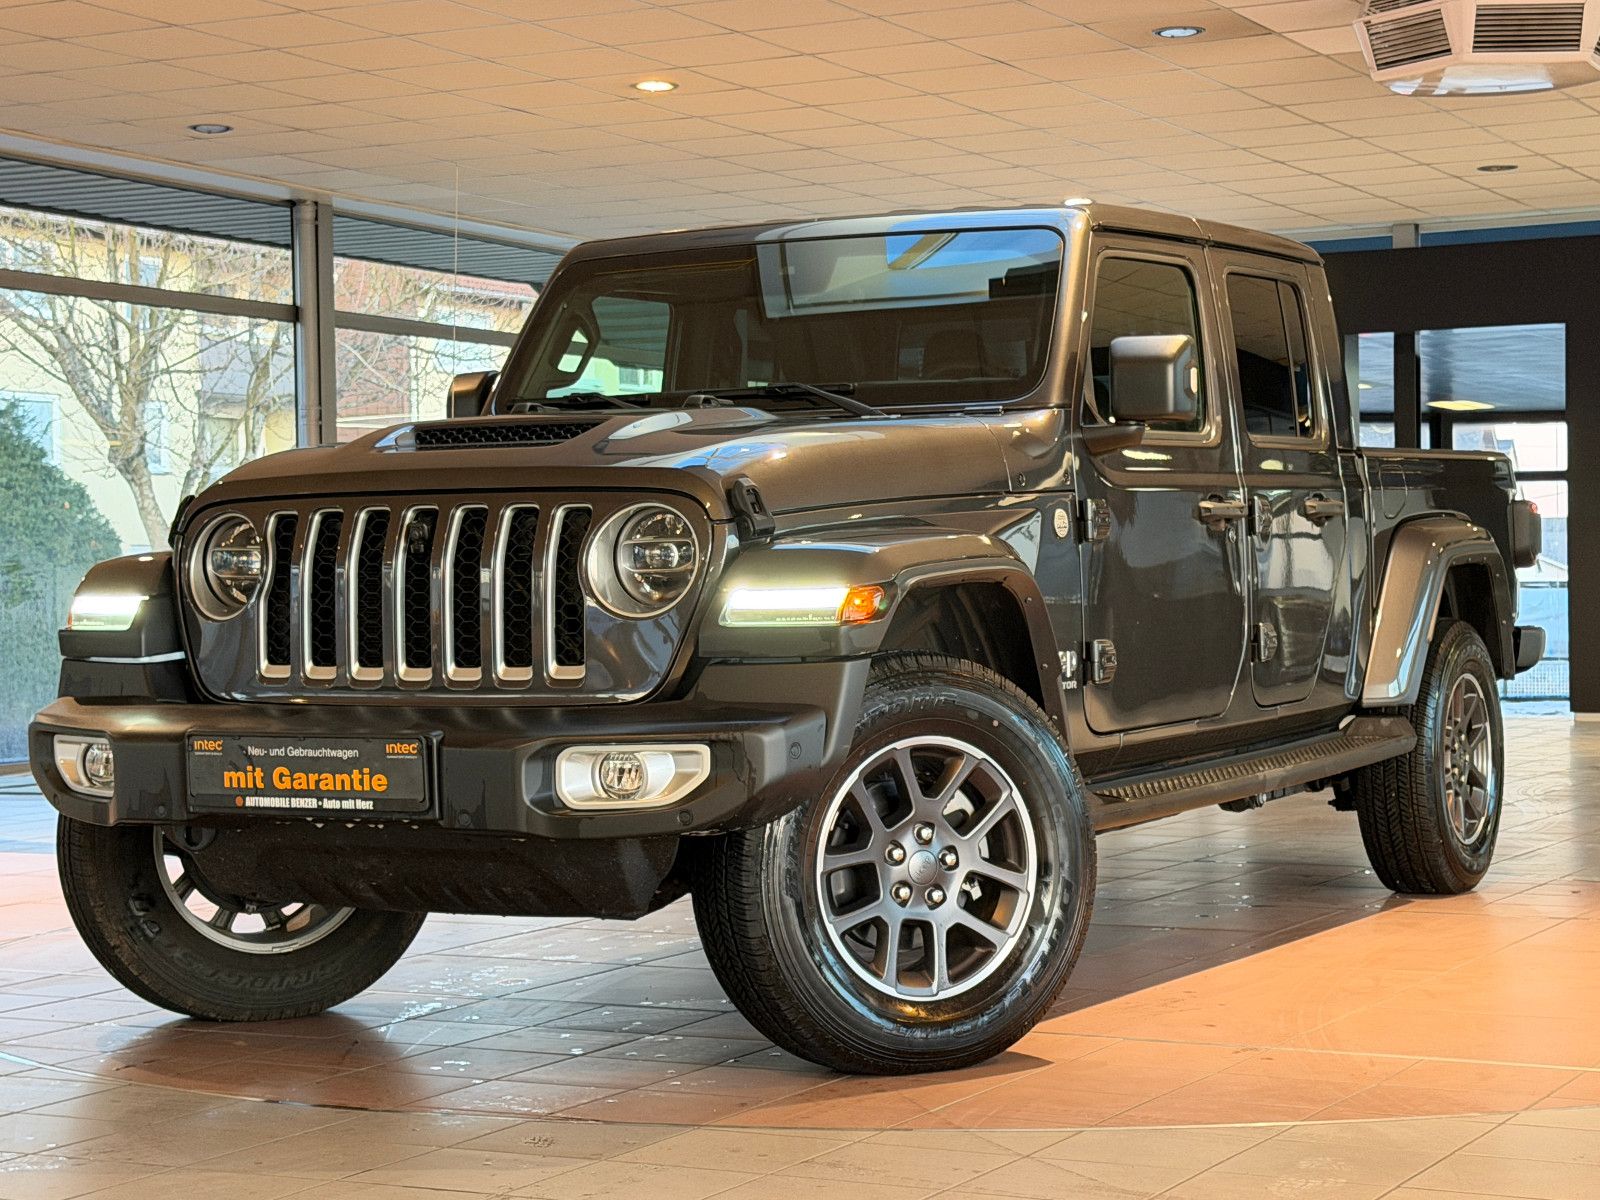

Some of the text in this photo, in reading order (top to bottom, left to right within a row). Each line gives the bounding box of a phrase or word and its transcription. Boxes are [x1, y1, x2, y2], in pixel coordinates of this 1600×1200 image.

[247, 745, 359, 760] Neu- und Gebrauchtwagen
[223, 765, 388, 792] mit Garantie
[245, 796, 290, 808] AUTOMOBILE
[322, 798, 341, 810] Auto
[341, 798, 355, 810] mit
[356, 799, 374, 810] Herz
